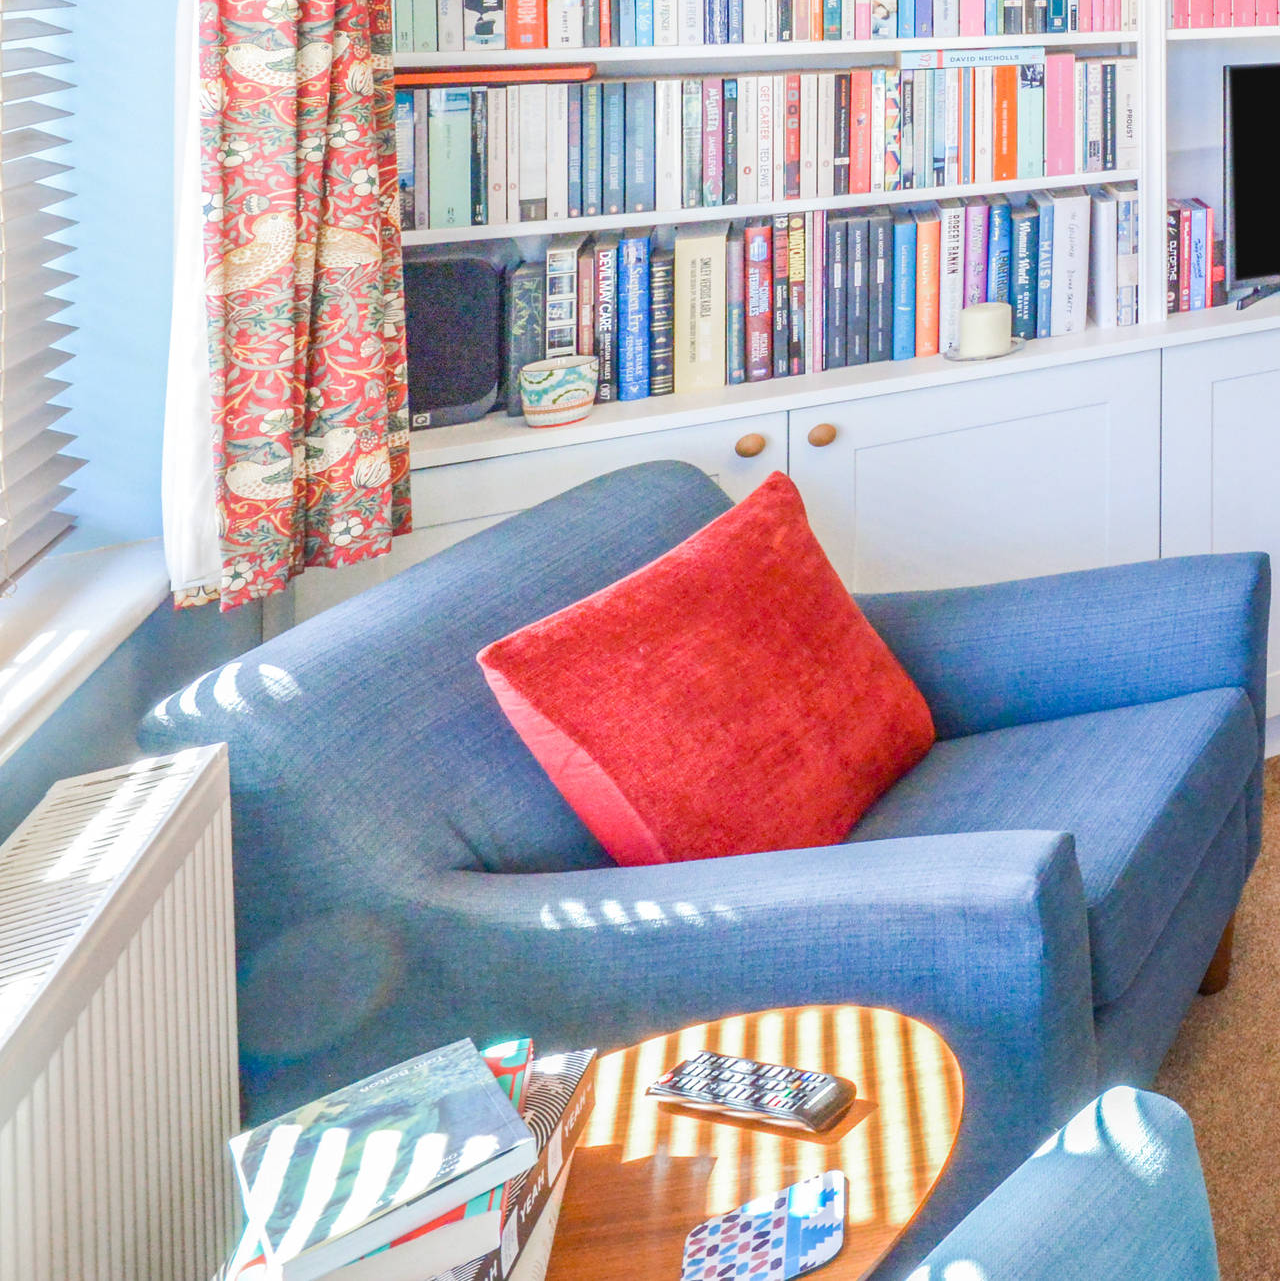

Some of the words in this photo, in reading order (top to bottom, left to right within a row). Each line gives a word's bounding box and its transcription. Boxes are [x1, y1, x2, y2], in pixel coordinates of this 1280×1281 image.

[949, 55, 976, 64] DAVID
[978, 54, 1020, 62] NICHOLLS
[760, 85, 770, 103] GET
[760, 105, 770, 141] CARTER
[760, 148, 770, 163] TED
[760, 164, 770, 187] LEWIS
[1017, 221, 1030, 258] Woman's
[598, 251, 612, 281] DEVIL
[699, 257, 712, 277] SMILEY
[789, 229, 805, 282] WATCHMEN
[947, 247, 960, 275] RANKIN
[1040, 241, 1050, 276] MAUS
[1017, 258, 1030, 284] World
[599, 280, 612, 303] MAY
[629, 267, 643, 311] Stephen
[699, 277, 712, 299] VERSUS
[599, 305, 613, 331] CARE
[699, 300, 712, 319] KARLA
[628, 315, 643, 333] Fry
[759, 333, 769, 358] MICHAEL
[413, 1054, 444, 1072] Tom
[359, 1069, 410, 1094] Bolton
[564, 1090, 587, 1138] YEAH
[520, 1169, 546, 1223] YEAH
